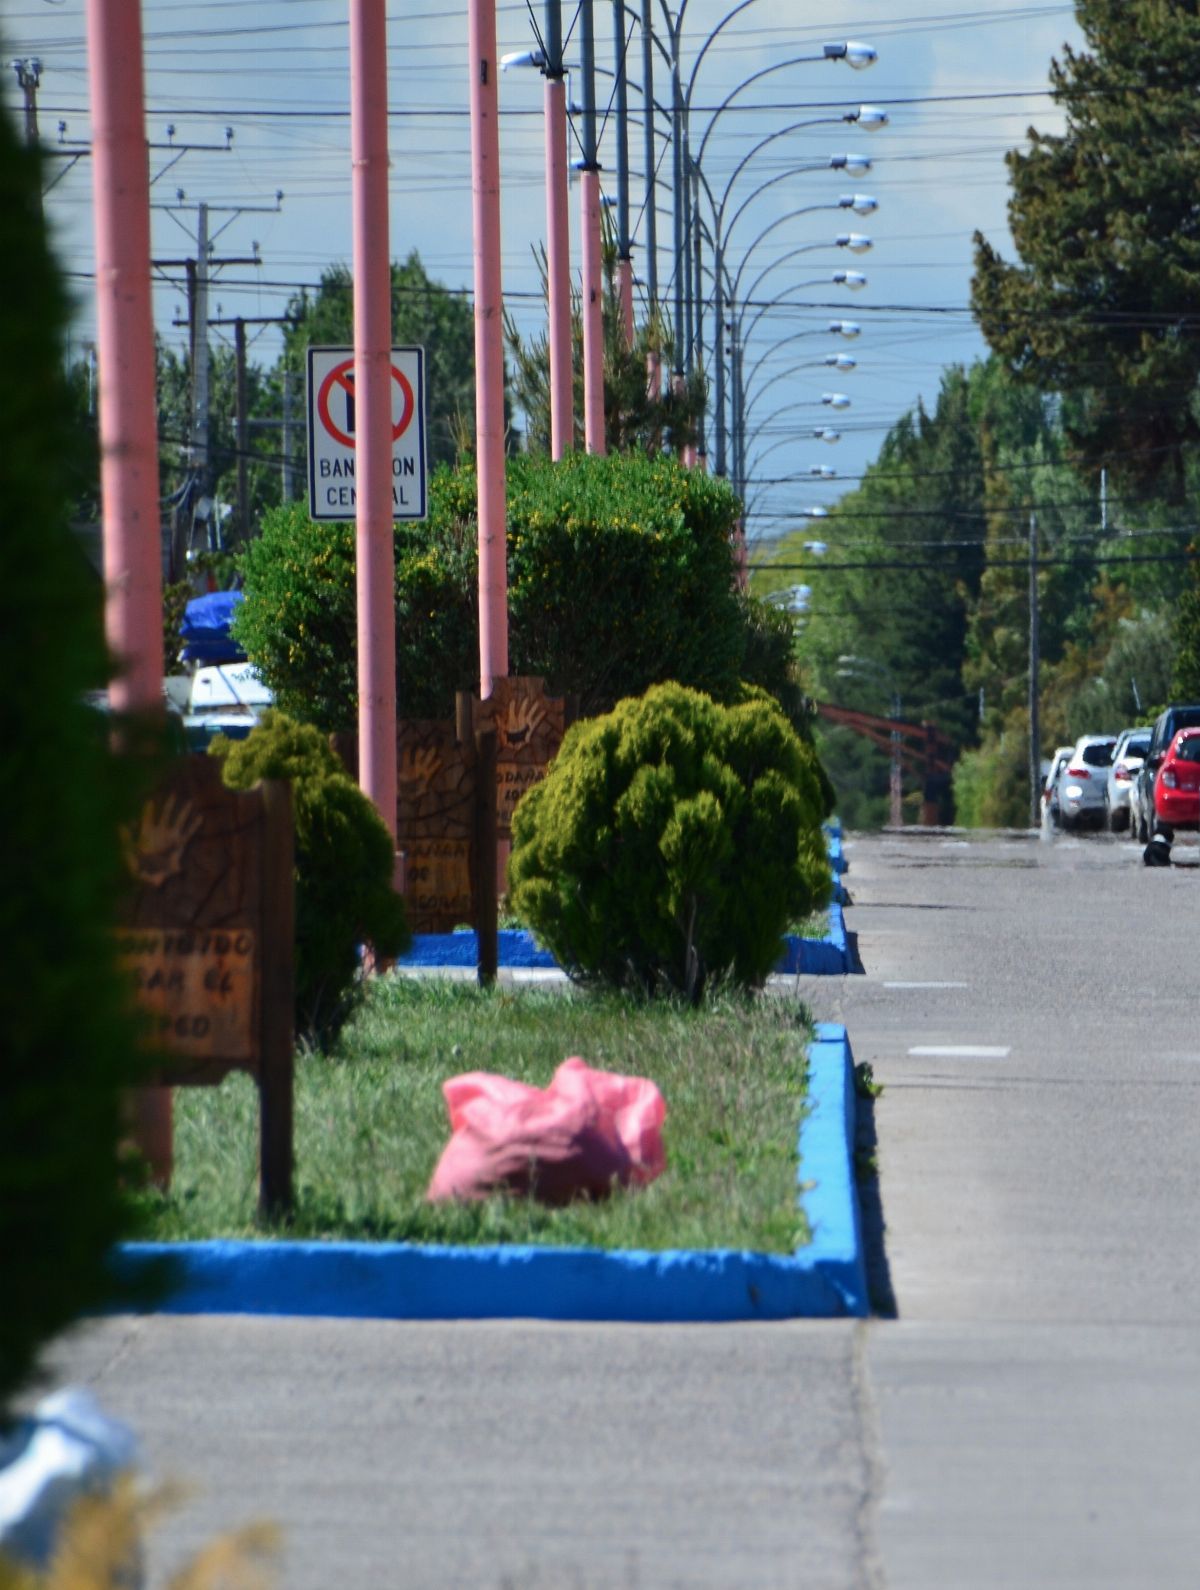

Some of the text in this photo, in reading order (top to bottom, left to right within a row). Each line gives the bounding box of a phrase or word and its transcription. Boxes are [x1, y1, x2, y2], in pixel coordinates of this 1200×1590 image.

[320, 457, 415, 478] BANON
[327, 486, 409, 506] CENAL
[505, 768, 545, 783] DAÑA
